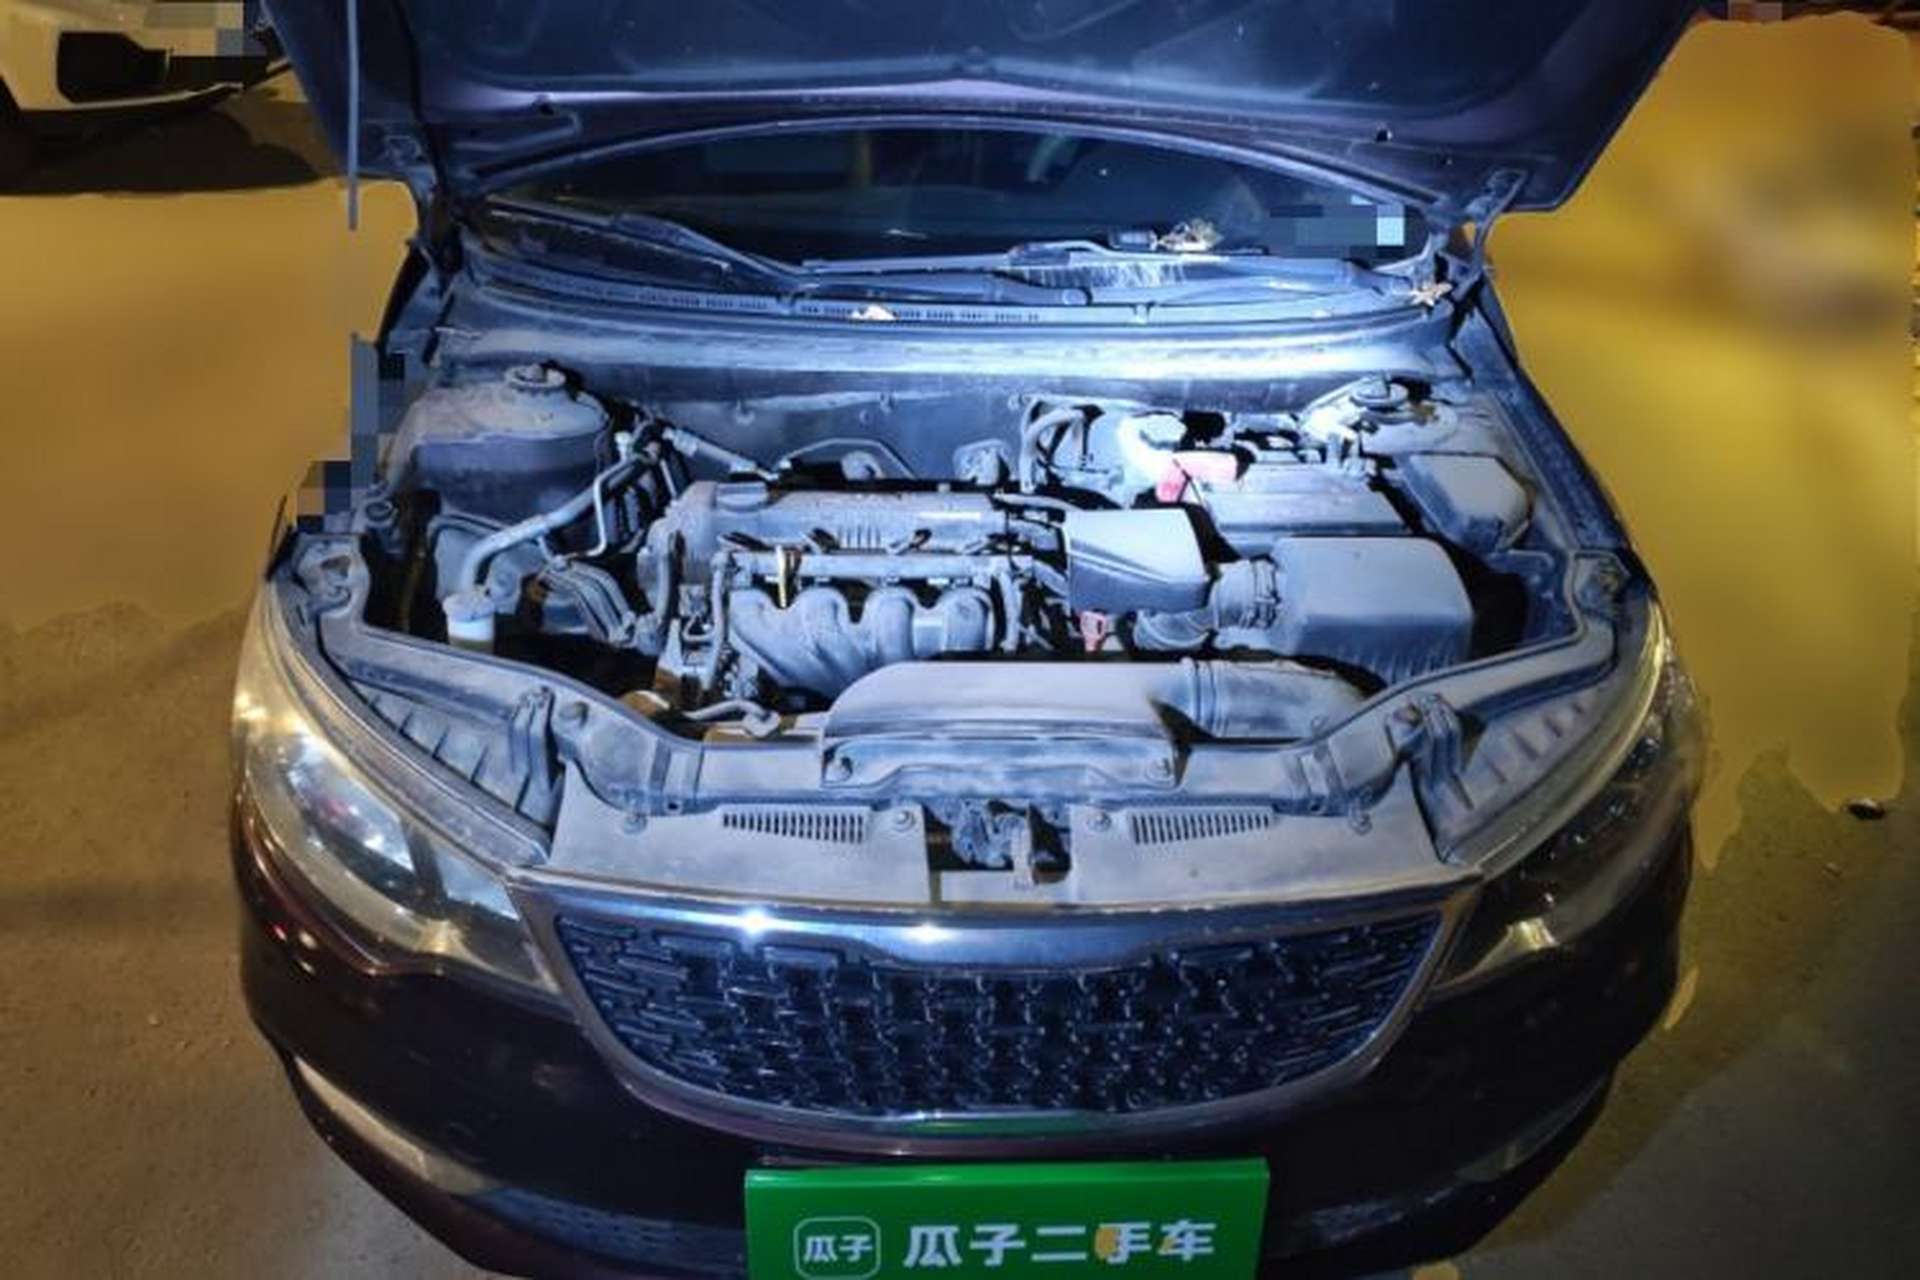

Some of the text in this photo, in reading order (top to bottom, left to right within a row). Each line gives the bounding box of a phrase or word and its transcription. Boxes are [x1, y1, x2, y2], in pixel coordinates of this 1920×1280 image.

[804, 1235, 873, 1262] 瓜子
[904, 1220, 1217, 1266] 瓜子二手车
